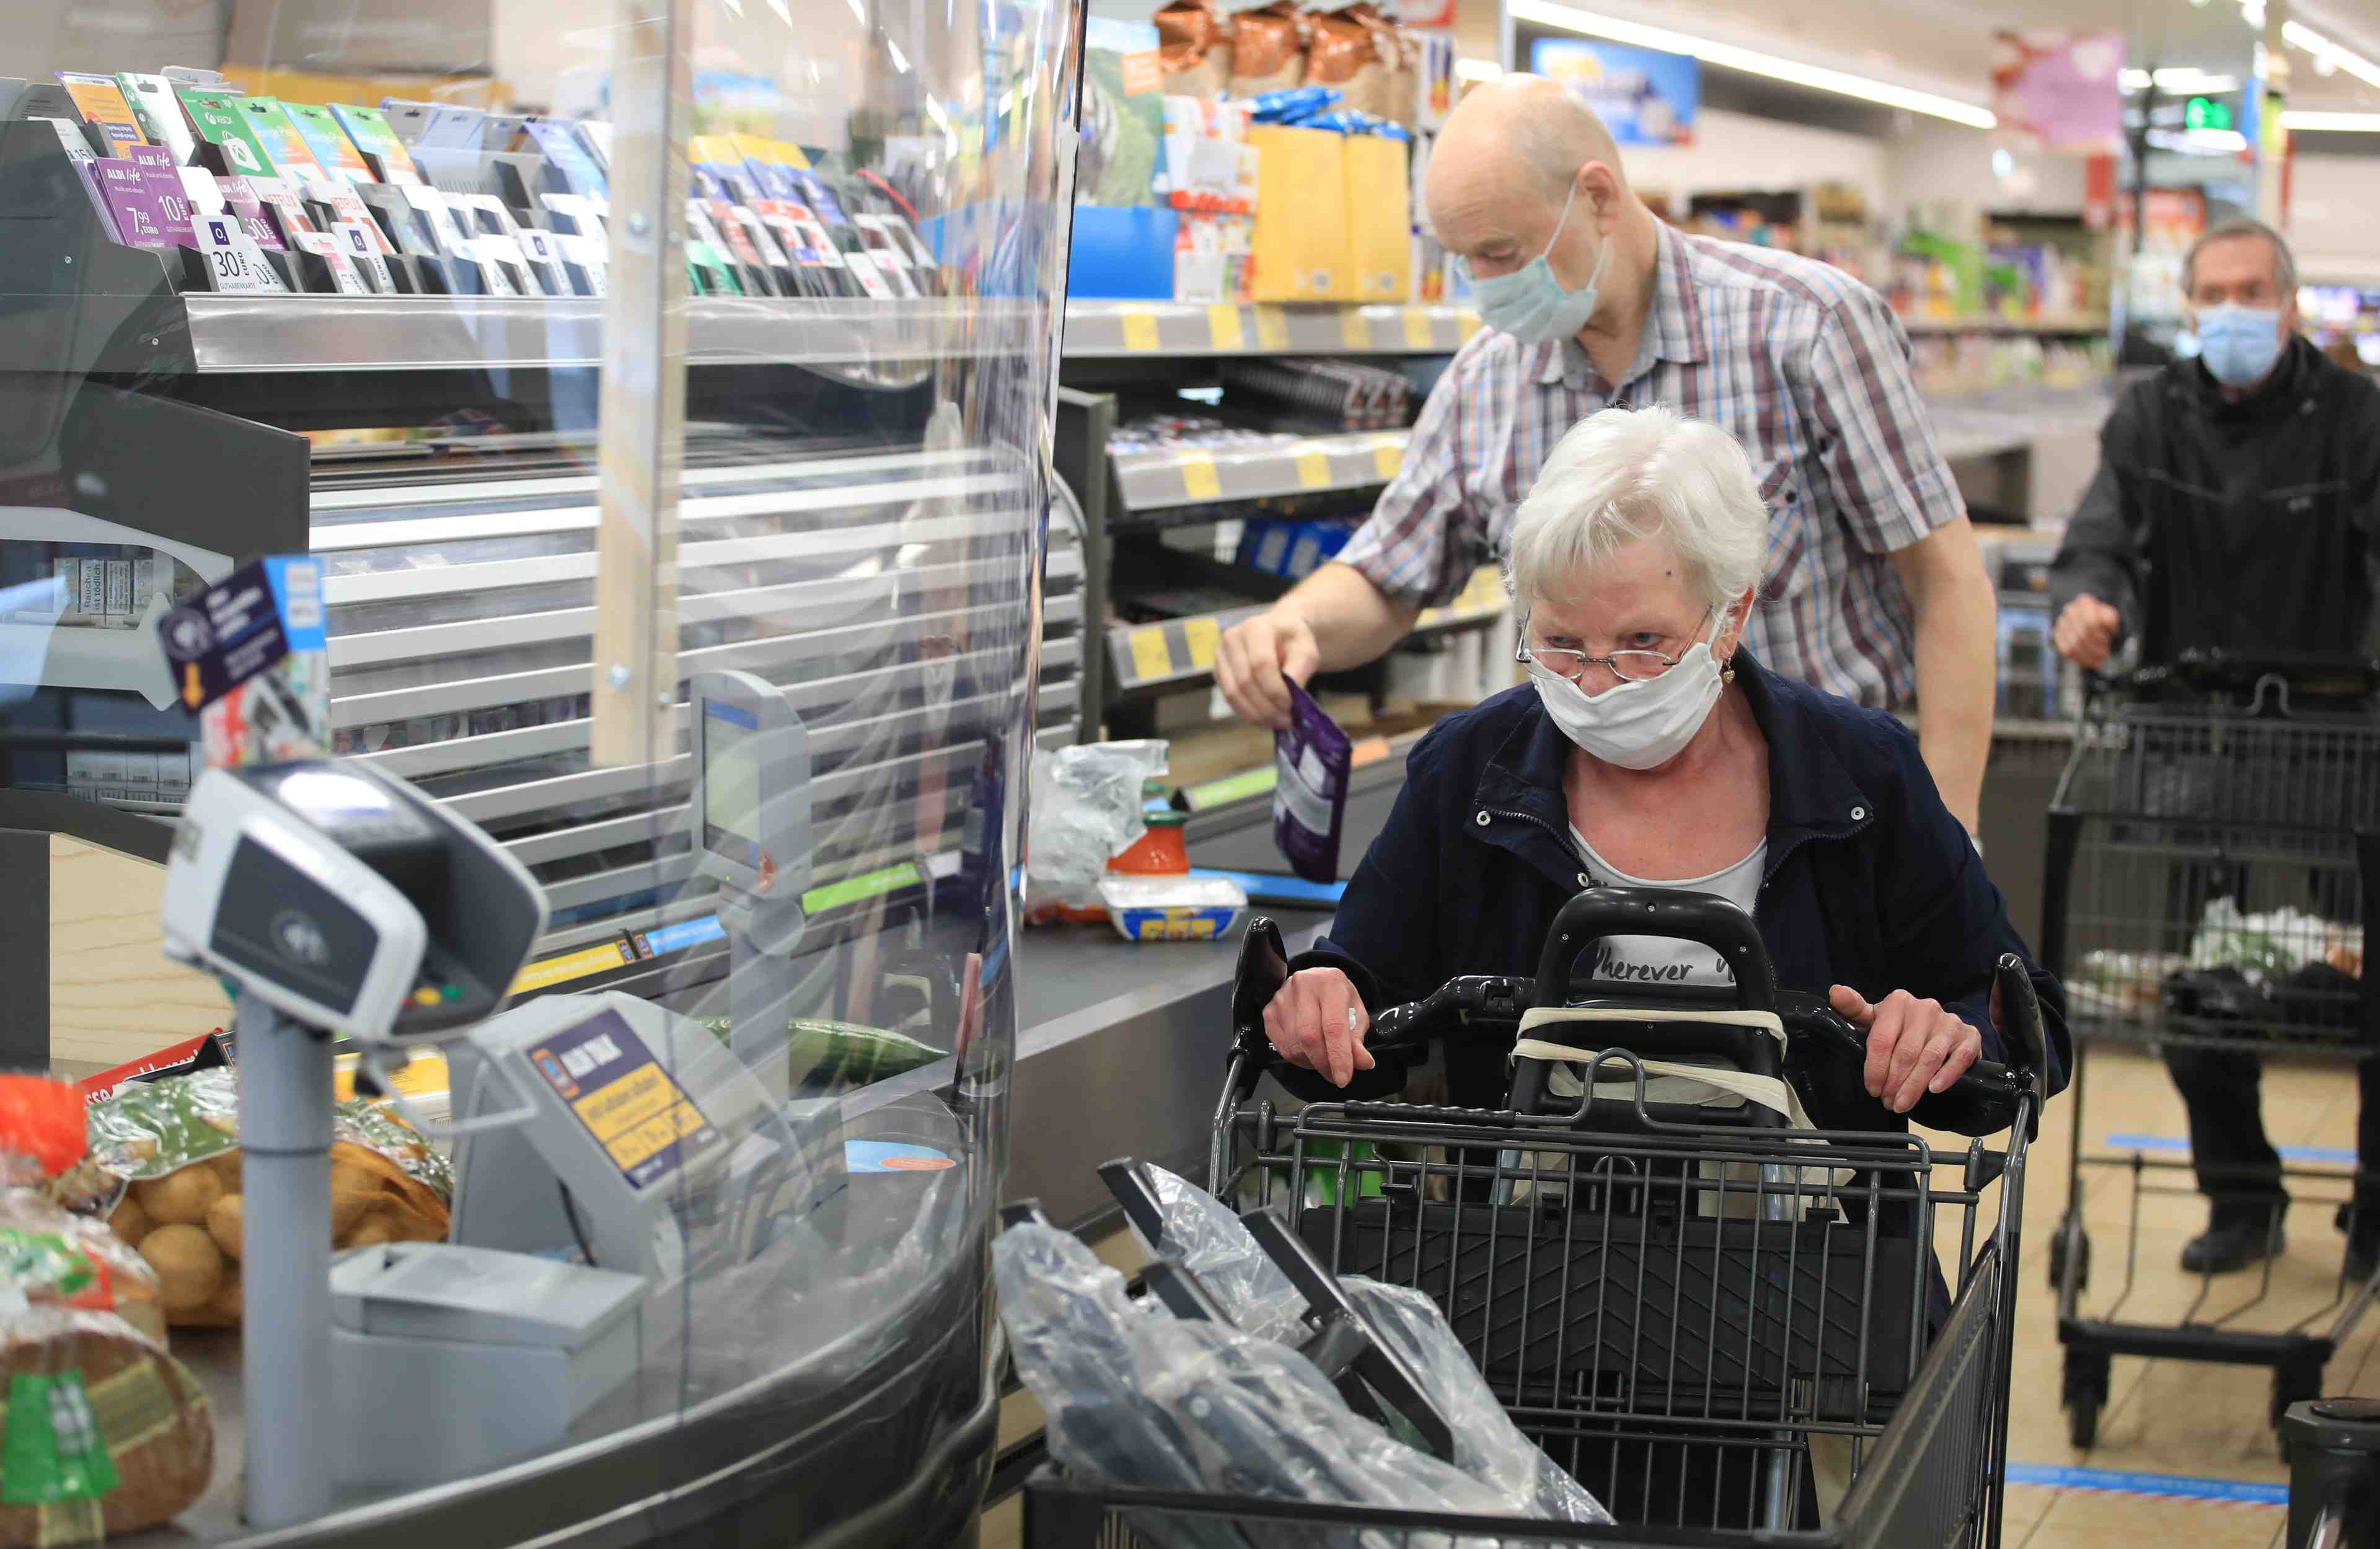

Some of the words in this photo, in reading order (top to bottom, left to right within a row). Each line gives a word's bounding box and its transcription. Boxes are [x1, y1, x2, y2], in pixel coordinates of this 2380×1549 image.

[138, 155, 155, 166] ALDI
[157, 152, 170, 170] life
[107, 169, 126, 180] ALDI
[126, 167, 141, 185] life
[159, 195, 181, 221] 10
[177, 197, 189, 220] EURO
[213, 251, 240, 277] 30
[237, 252, 250, 276] EURO
